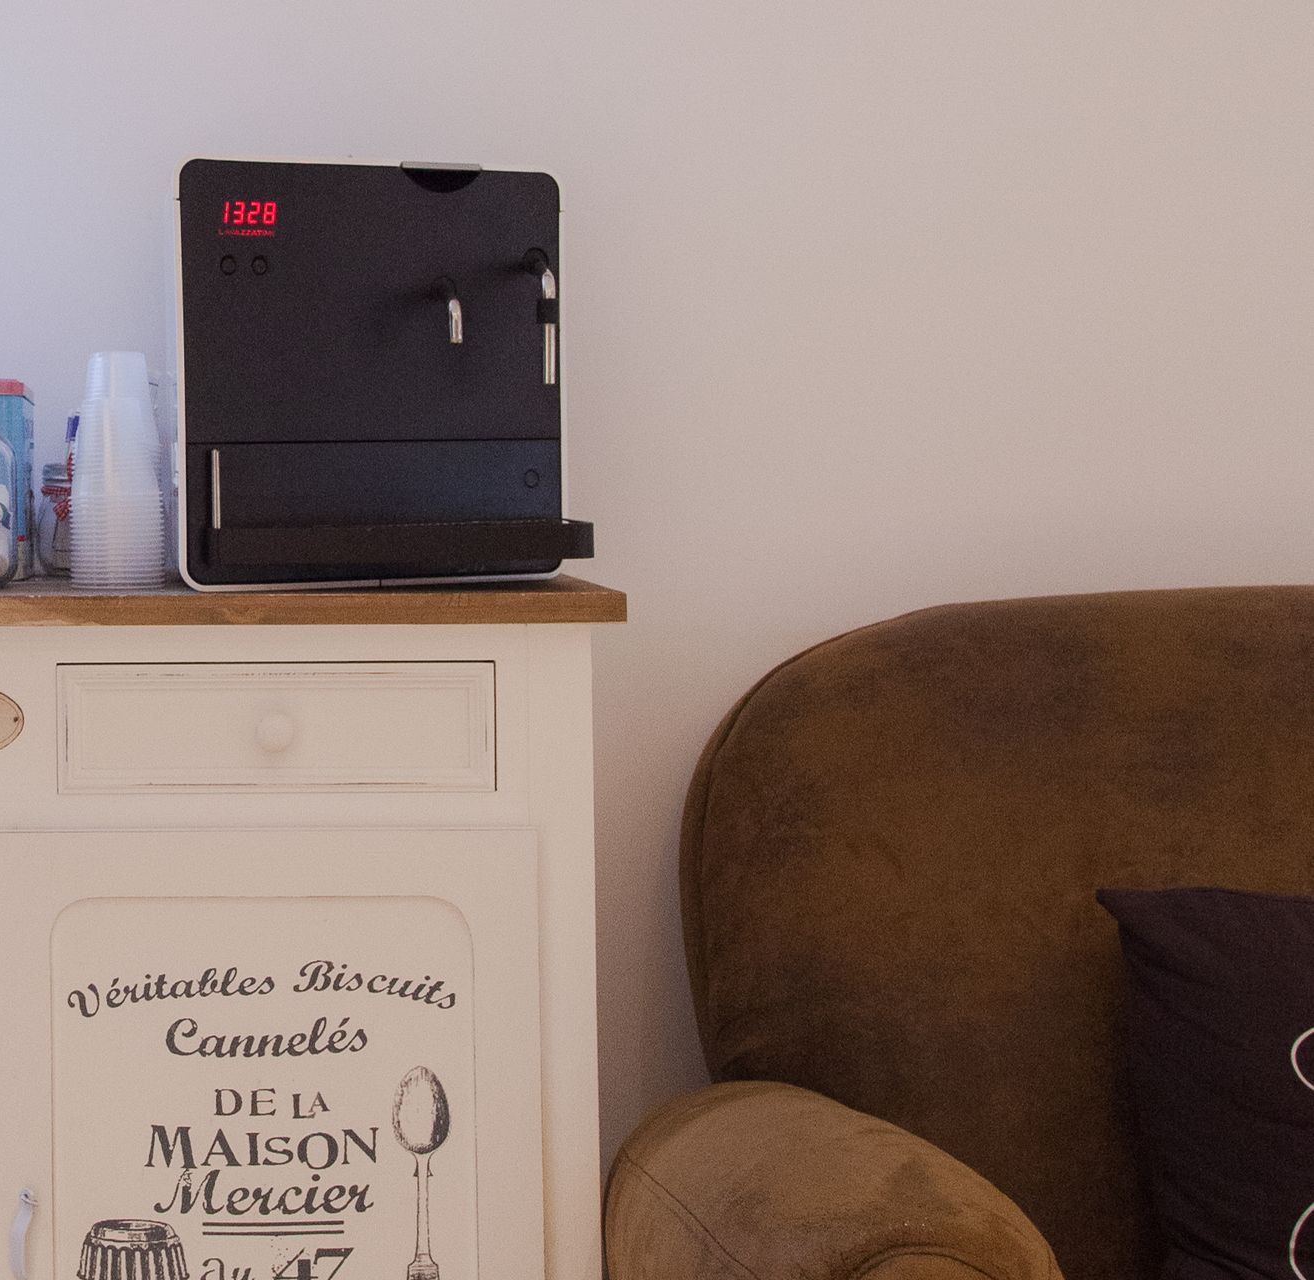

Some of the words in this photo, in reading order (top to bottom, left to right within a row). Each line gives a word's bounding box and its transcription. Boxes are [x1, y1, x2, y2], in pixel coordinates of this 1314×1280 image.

[223, 201, 277, 225] 1328
[68, 967, 275, 1017] Véritables
[293, 960, 455, 1009] Biscuits
[166, 1017, 367, 1058] Cannelés
[214, 1088, 276, 1116] DE
[292, 1092, 330, 1119] LA
[145, 1125, 378, 1170] MAISON
[154, 1169, 374, 1215] Mercier
